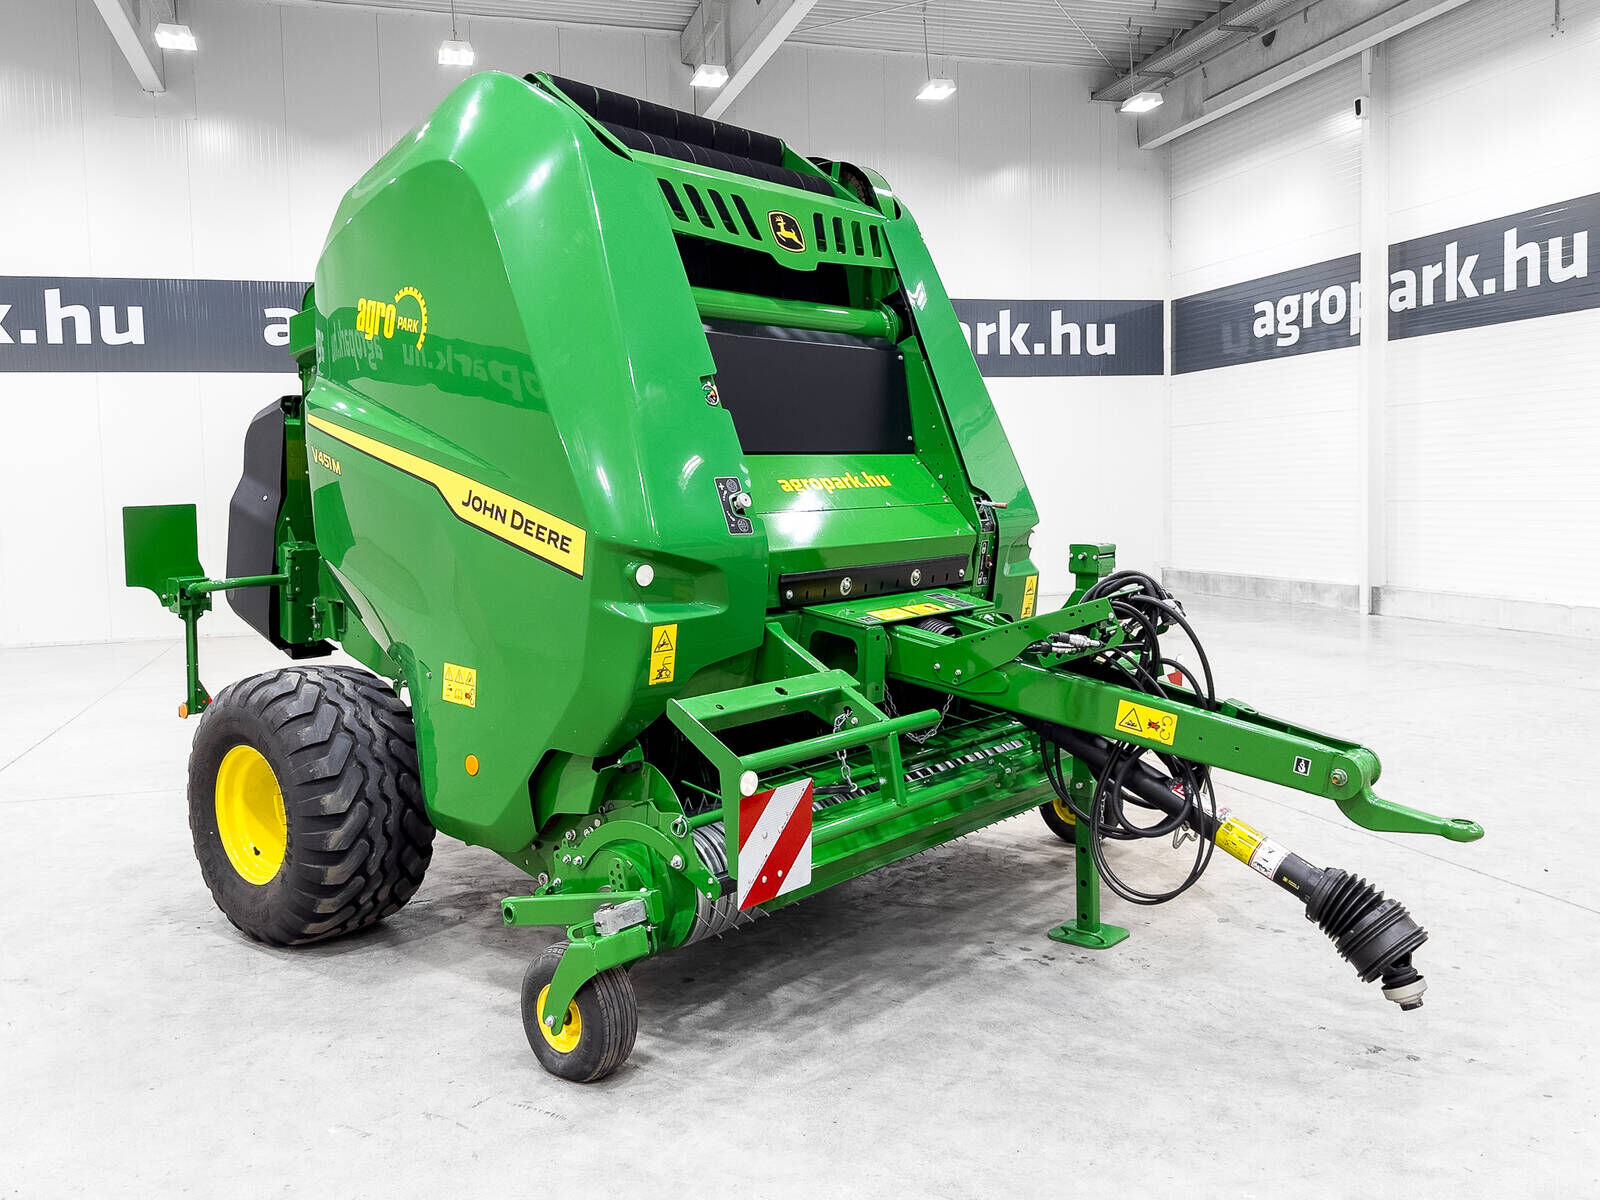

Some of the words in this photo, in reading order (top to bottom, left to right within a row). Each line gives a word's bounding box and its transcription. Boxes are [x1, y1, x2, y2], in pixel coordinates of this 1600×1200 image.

[356, 297, 397, 341] agro
[397, 315, 419, 334] PARK
[311, 446, 342, 476] V451M
[776, 471, 893, 495] agropark.hu
[461, 489, 508, 525] JOHN
[509, 509, 573, 554] DEERE
